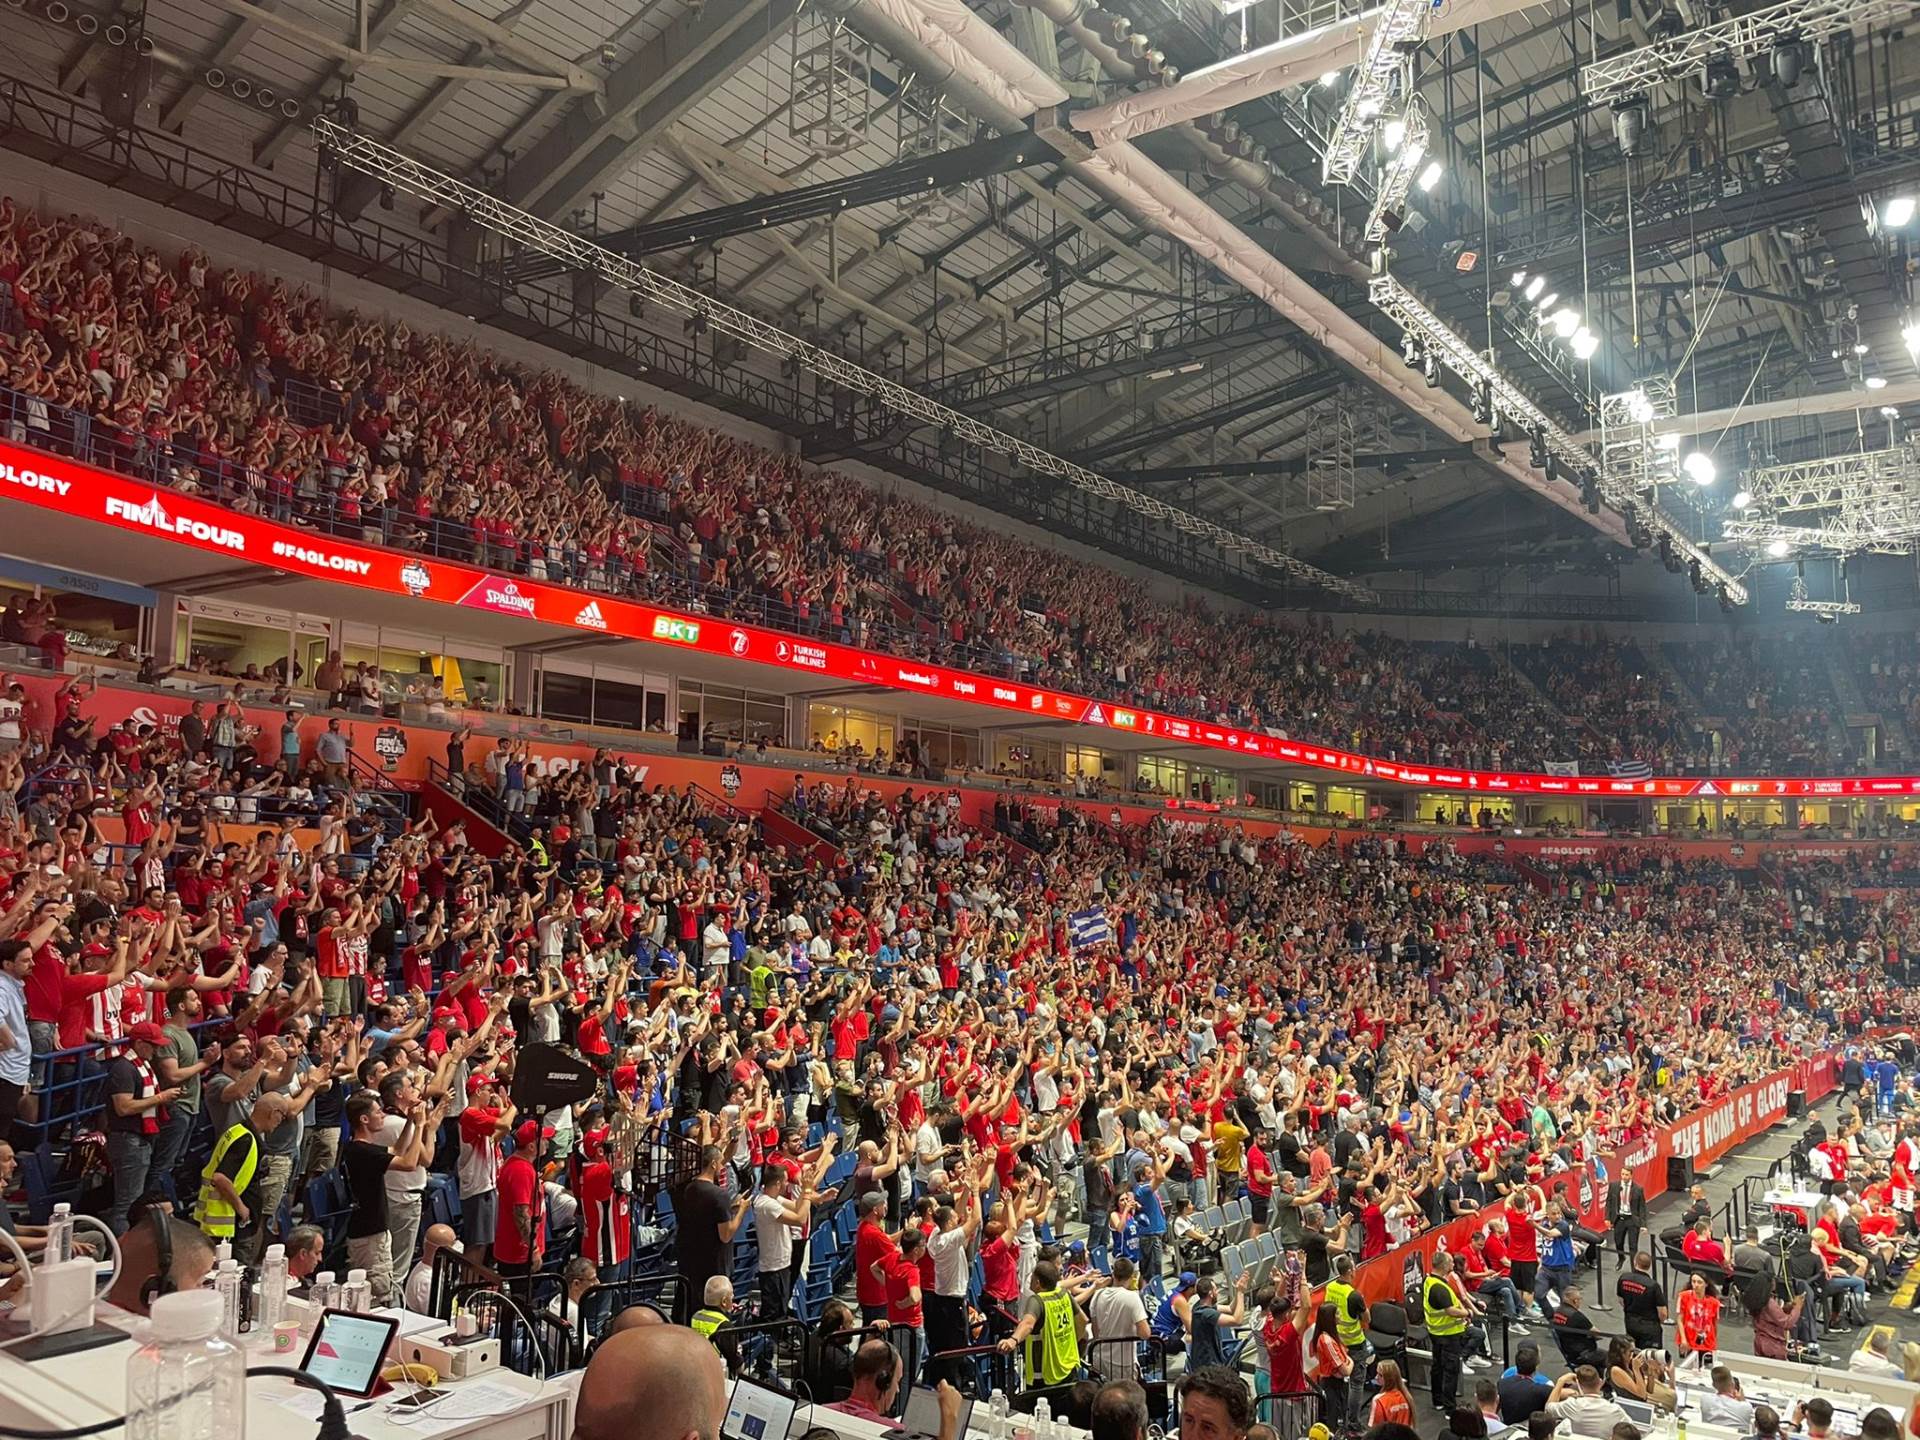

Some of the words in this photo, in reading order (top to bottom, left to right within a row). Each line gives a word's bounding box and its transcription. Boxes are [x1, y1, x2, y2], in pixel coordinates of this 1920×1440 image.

[106, 493, 175, 532] FINAL
[176, 516, 245, 550] FOUR
[272, 541, 372, 575] #F4GLORY
[486, 588, 535, 612] SPALDING
[575, 616, 607, 629] adidas
[654, 618, 699, 641] BKT
[793, 644, 826, 659] TURKISH
[792, 654, 826, 668] AIRLINES
[1113, 710, 1136, 726] BKT
[375, 744, 406, 754] FOUR
[547, 1072, 579, 1081] SHURE
[1672, 1122, 1700, 1158] THE
[1704, 1101, 1736, 1150] HOME
[1738, 1092, 1752, 1127] OF
[1757, 1076, 1790, 1119] GLORY
